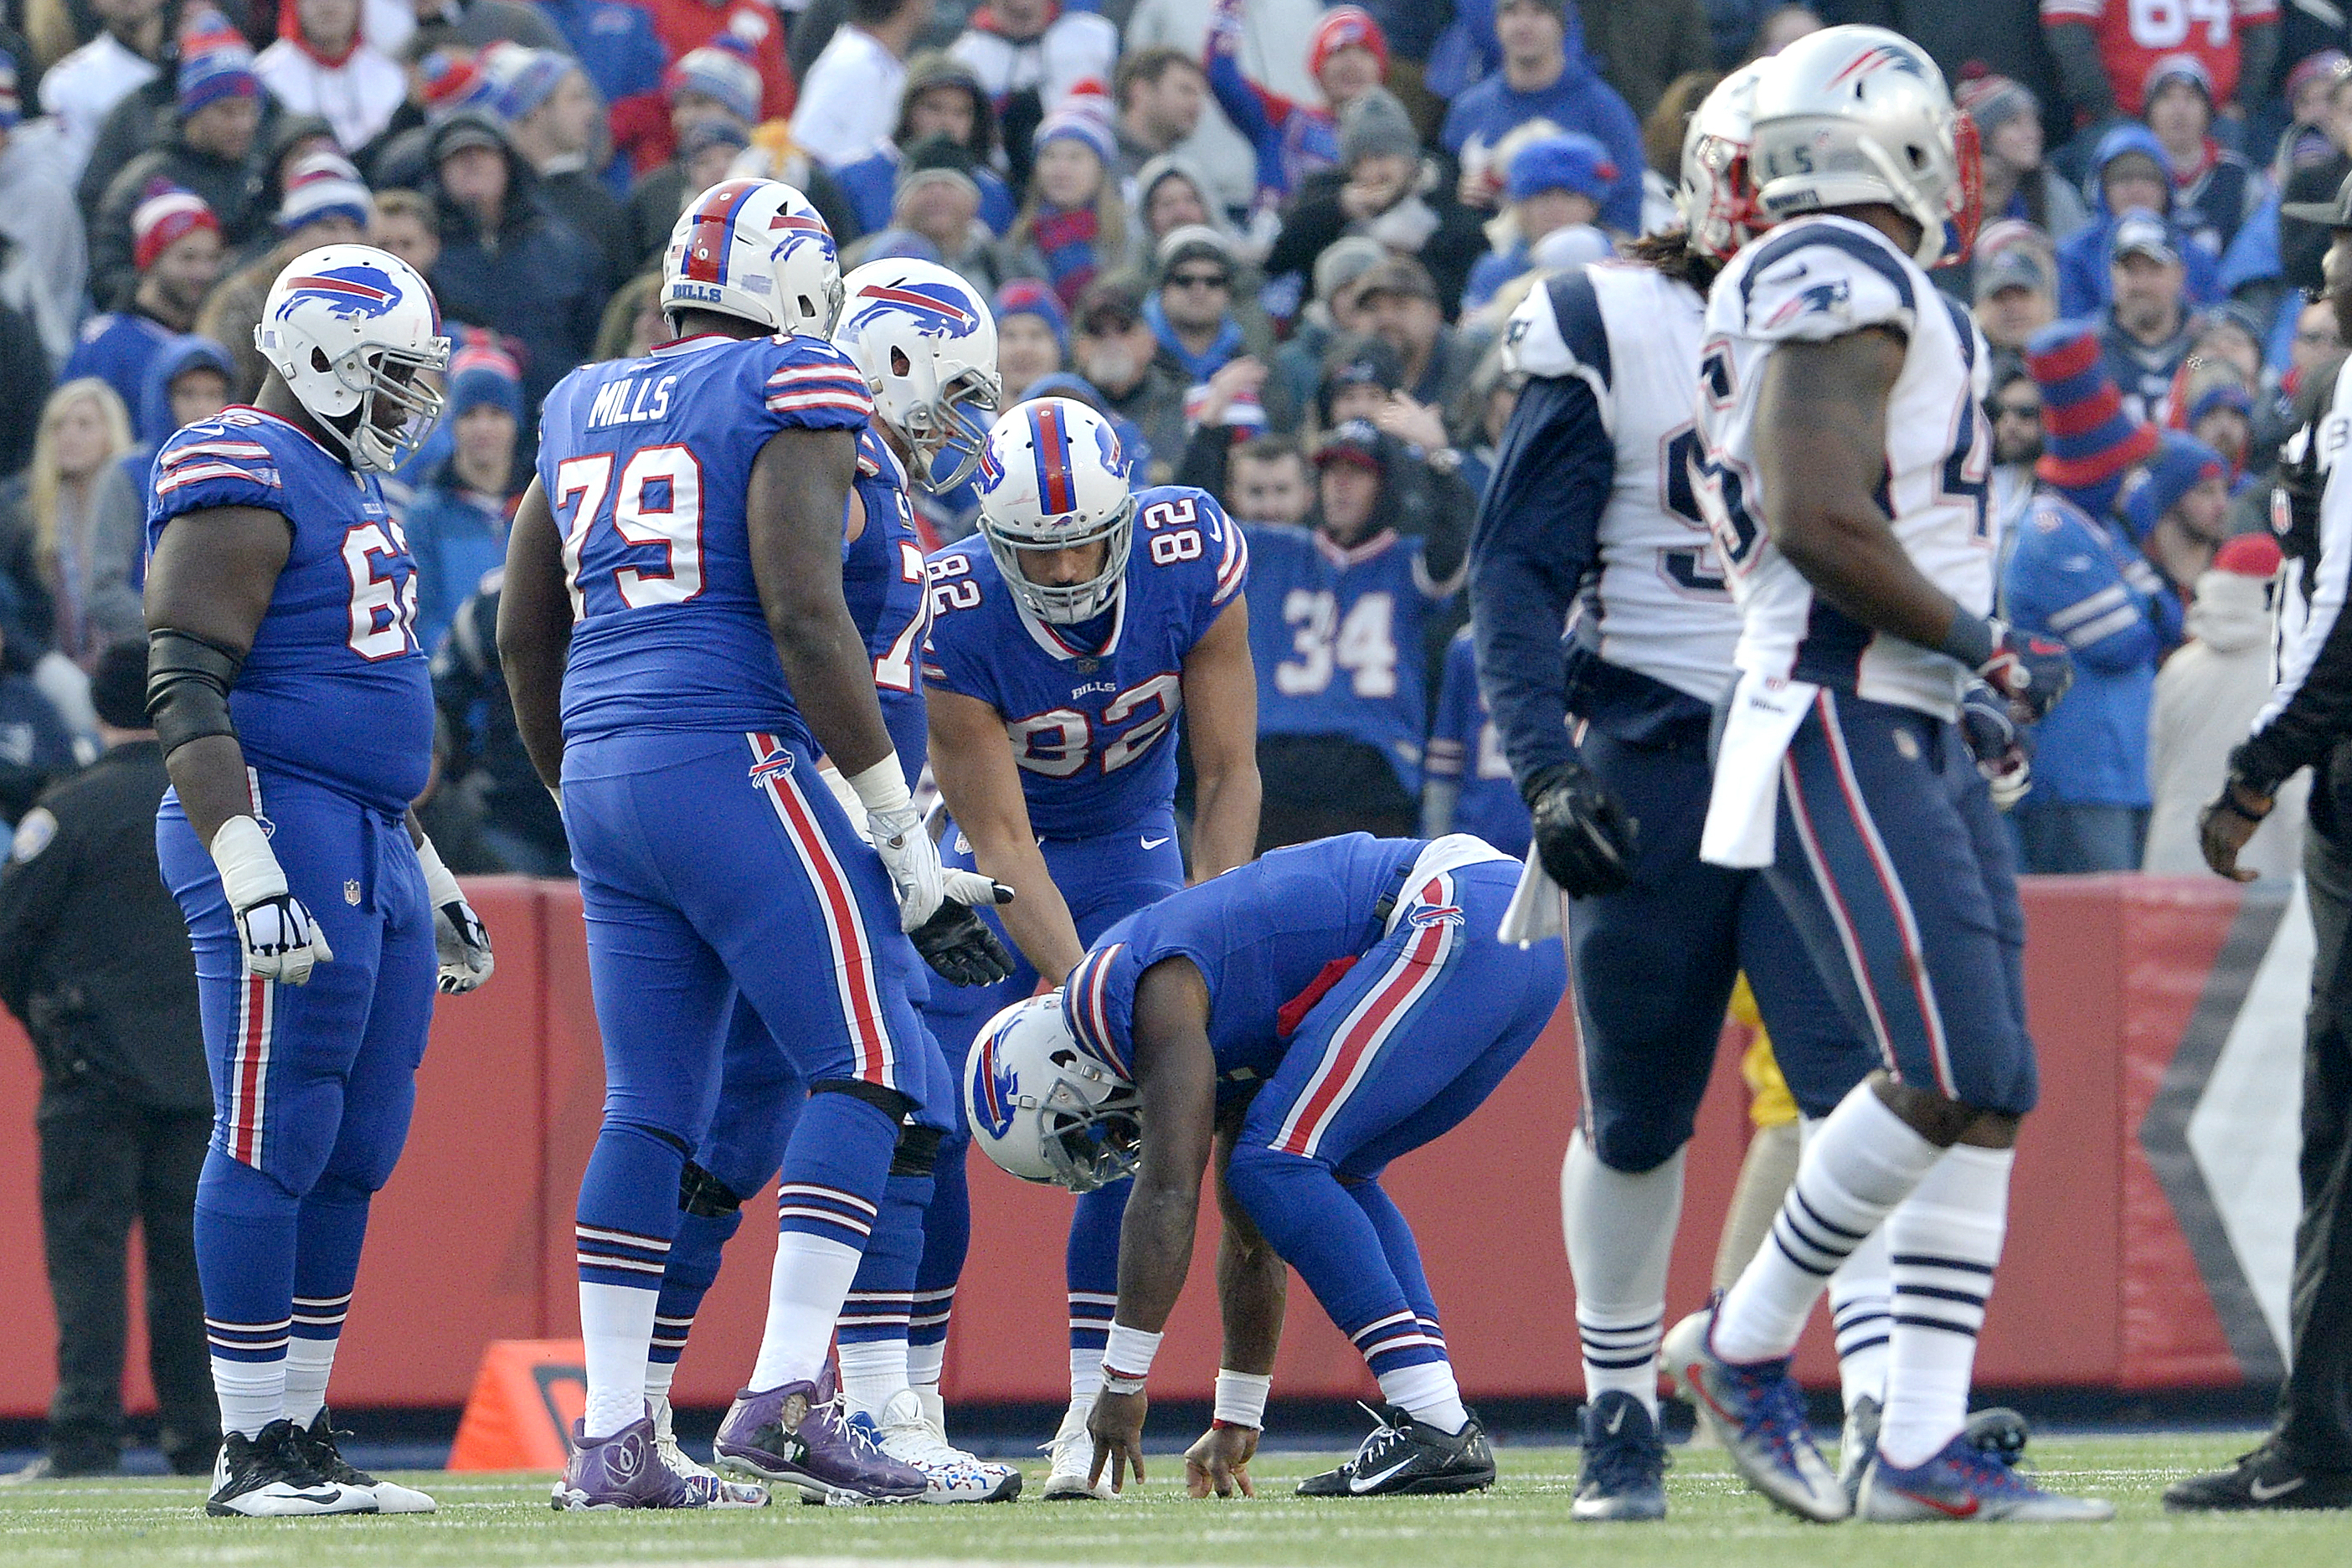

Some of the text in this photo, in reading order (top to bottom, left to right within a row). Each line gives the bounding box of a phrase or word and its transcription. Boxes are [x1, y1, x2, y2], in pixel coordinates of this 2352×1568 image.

[672, 283, 723, 303] BILLS
[588, 374, 677, 429] MILLS
[557, 442, 706, 625] 79
[1141, 496, 1204, 568] 82
[872, 540, 935, 694] 7
[1274, 588, 1397, 698] 34
[1005, 671, 1186, 780] 82
[1071, 681, 1117, 701] BILLS
